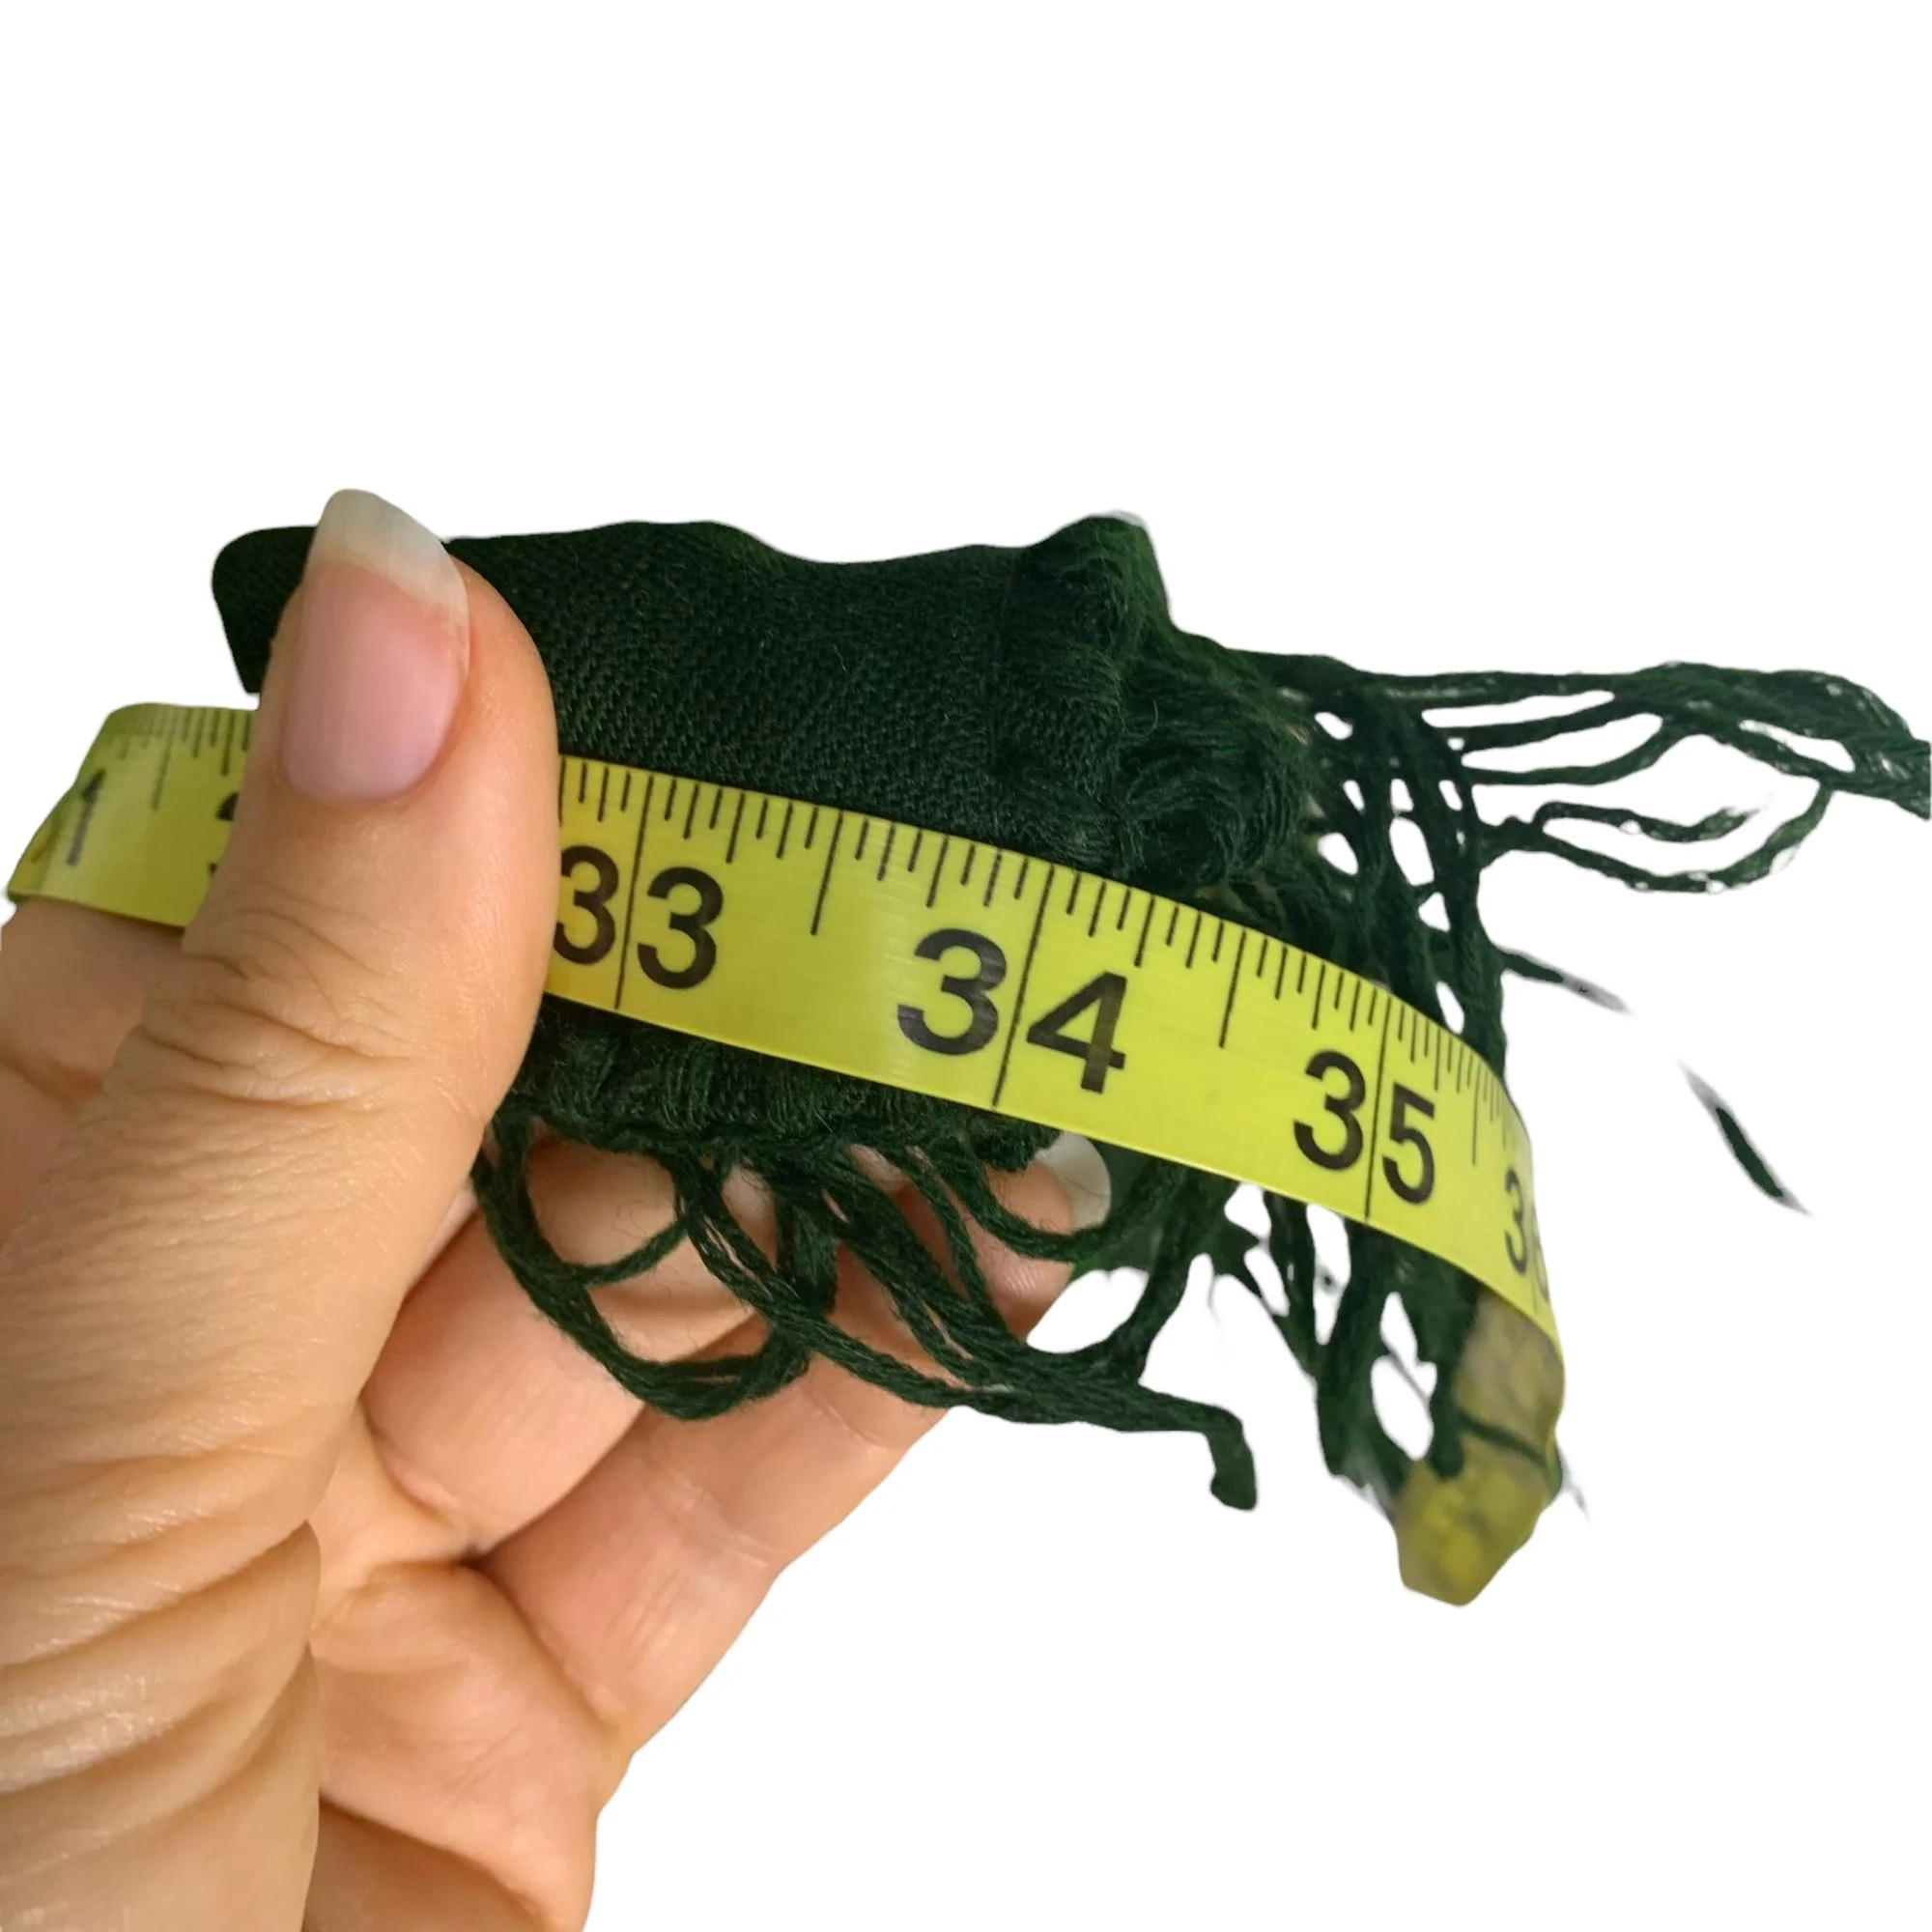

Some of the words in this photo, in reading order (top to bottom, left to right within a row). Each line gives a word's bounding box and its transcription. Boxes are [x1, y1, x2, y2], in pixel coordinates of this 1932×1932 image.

[554, 844, 724, 989] 33
[896, 928, 1127, 1094] 34
[1293, 1049, 1435, 1205] 35
